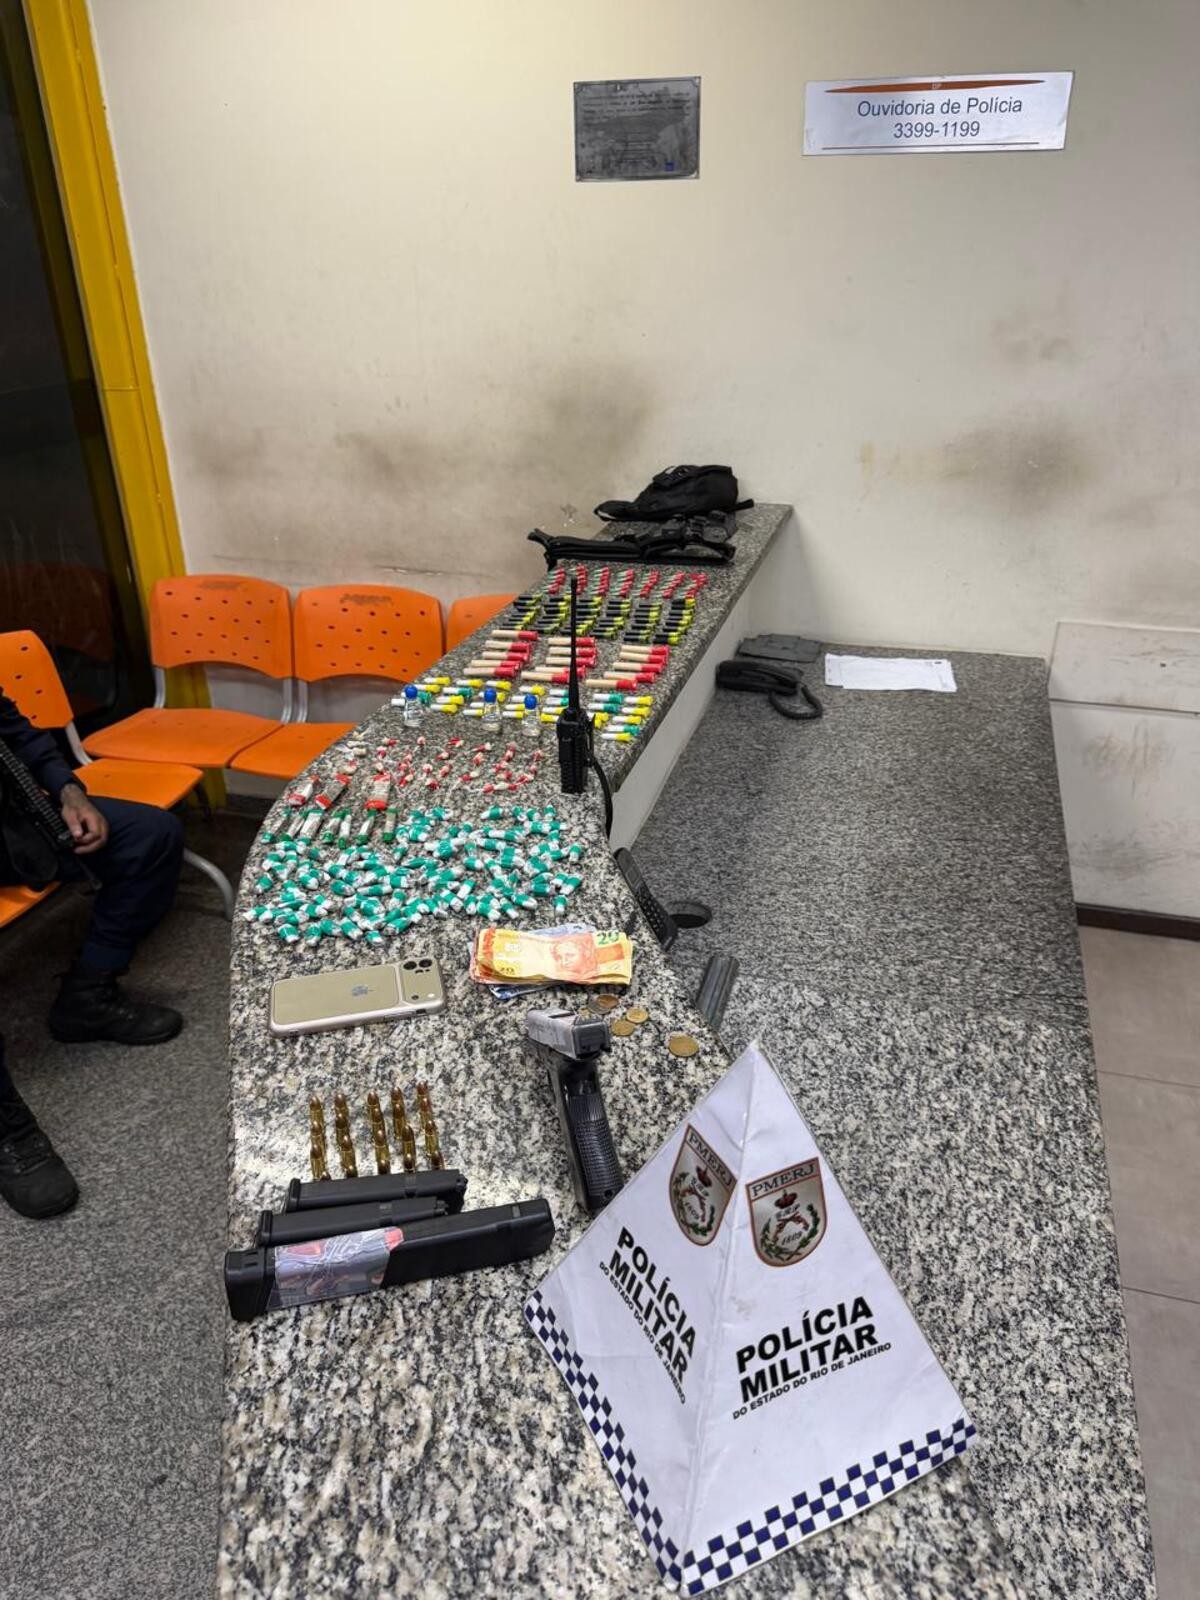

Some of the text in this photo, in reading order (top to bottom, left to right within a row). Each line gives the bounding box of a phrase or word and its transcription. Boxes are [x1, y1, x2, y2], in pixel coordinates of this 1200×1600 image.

[857, 96, 1022, 117] Ouvidoria de Polícia
[893, 121, 980, 138] 3399-1199
[688, 1131, 733, 1187] PMERJ
[752, 1163, 815, 1197] PMERJ
[609, 1250, 688, 1384] MILITAR
[617, 1226, 696, 1358] POLÍCIA
[599, 1261, 686, 1405] DO ESTADO DO RIO DE JANEIRO
[736, 1296, 873, 1374] POLÍCIA
[740, 1323, 878, 1404] MILITAR
[732, 1342, 892, 1420] DO ESTADO DO RIO DE JANEIRO
